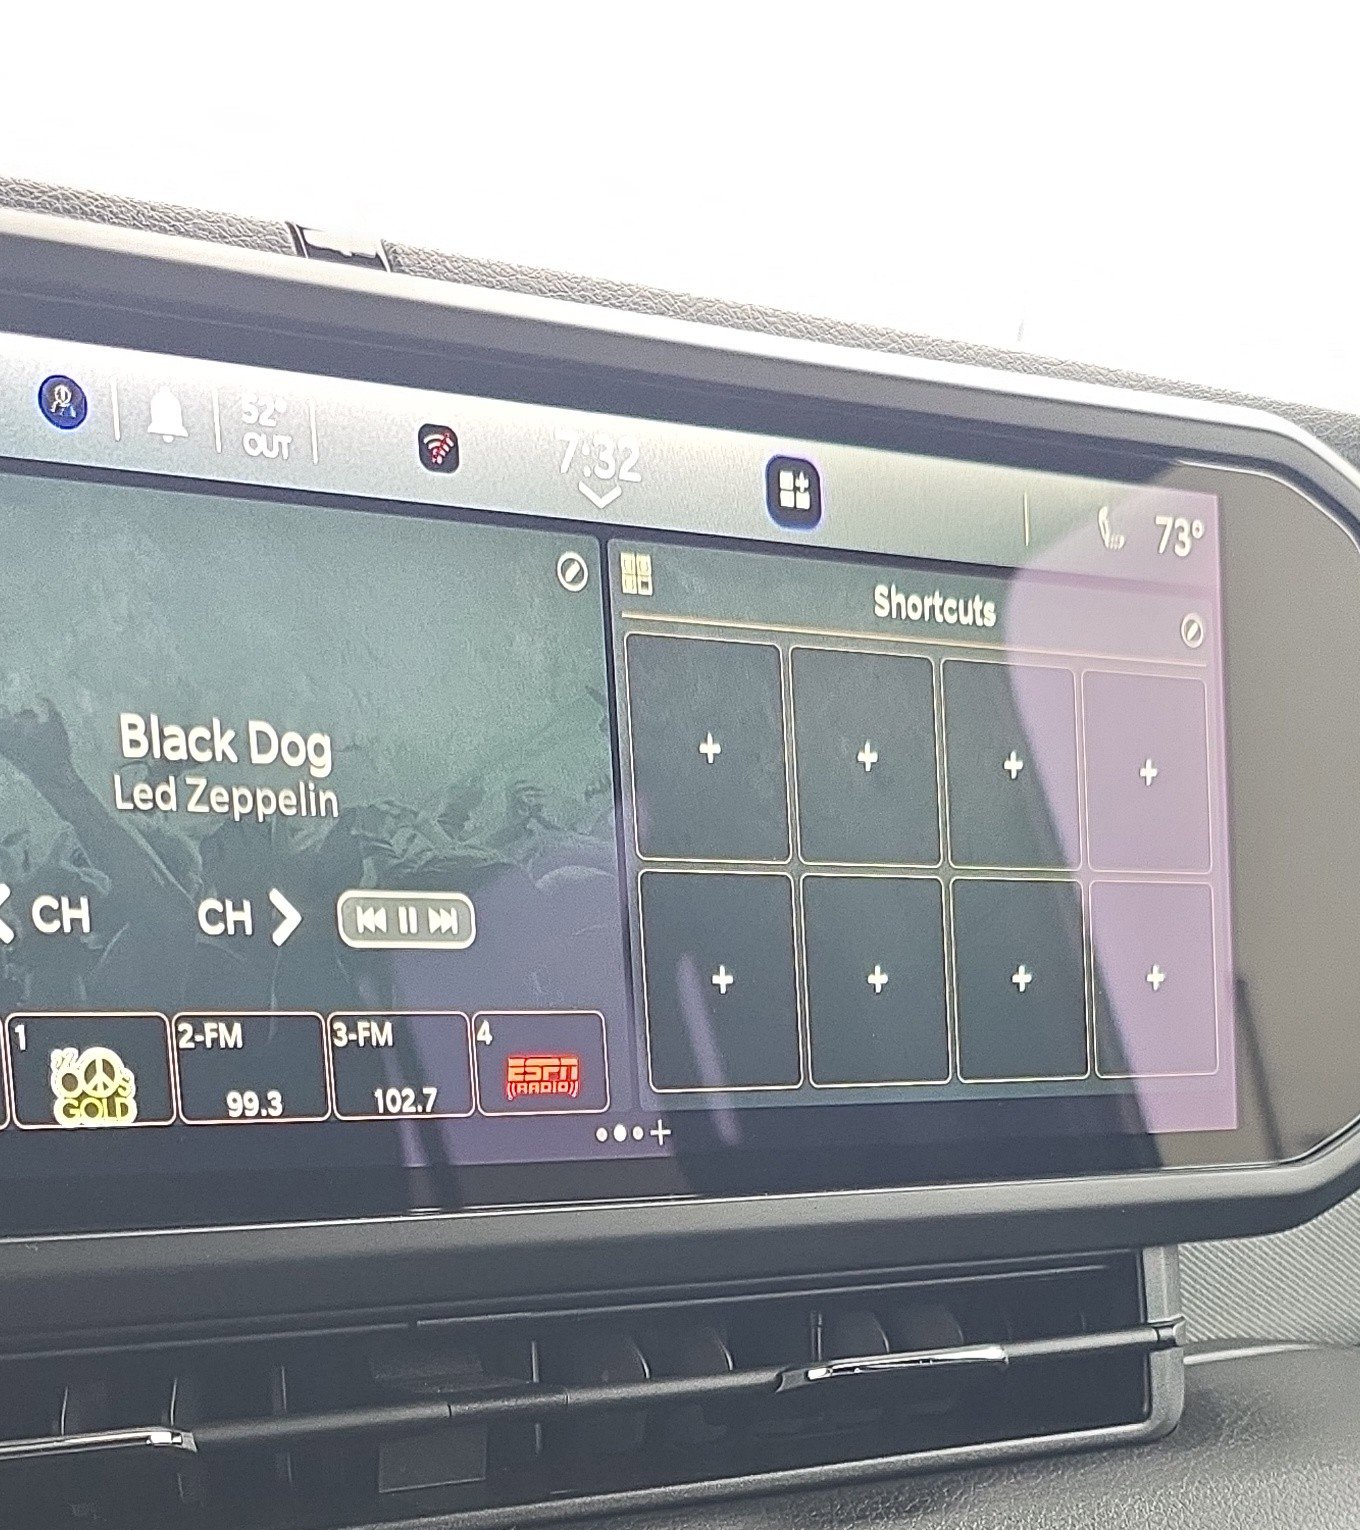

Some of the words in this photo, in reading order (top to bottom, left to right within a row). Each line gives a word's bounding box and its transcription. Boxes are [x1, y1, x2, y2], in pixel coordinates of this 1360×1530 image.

[242, 431, 293, 460] OUT
[553, 428, 642, 482] 7:32
[1154, 516, 1205, 557] 73°
[874, 584, 996, 628] Shortcuts
[120, 713, 238, 763] Black
[248, 720, 332, 777] Dog
[113, 775, 176, 811] Led
[186, 777, 339, 822] Zeppelin
[31, 895, 91, 934] CH
[198, 897, 253, 935] CH
[14, 1024, 27, 1051] 1
[178, 1021, 243, 1049] 2-FM
[333, 1021, 393, 1048] 3-FM
[476, 1020, 492, 1045] 4
[507, 1057, 579, 1081] ESPN
[374, 1088, 437, 1114] 102.7
[516, 1081, 569, 1095] RADIO
[55, 1097, 136, 1125] GOLD
[227, 1090, 283, 1118] 99.3
